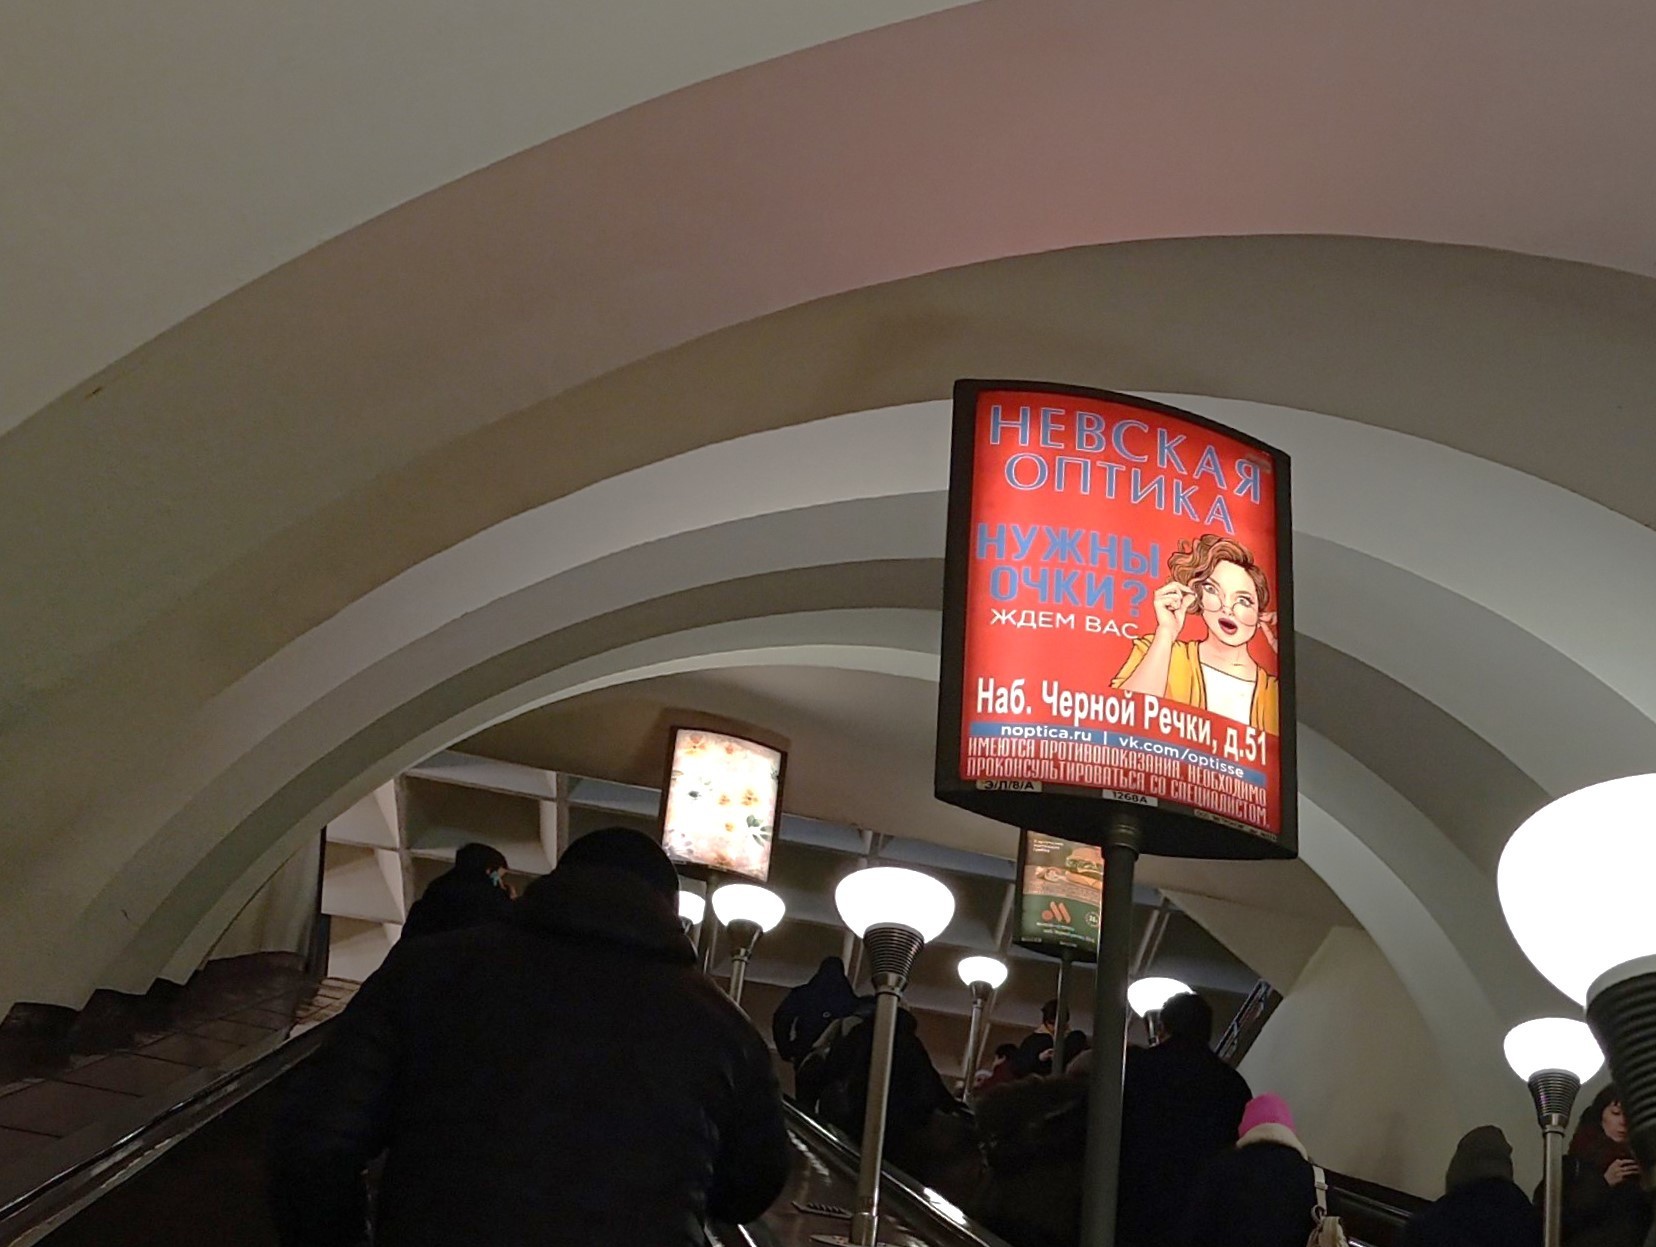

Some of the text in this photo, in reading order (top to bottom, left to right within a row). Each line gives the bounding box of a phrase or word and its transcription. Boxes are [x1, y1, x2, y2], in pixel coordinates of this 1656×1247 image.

[989, 405, 1260, 504] НЕВСКАЯ
[1005, 453, 1235, 534] ОПТИКА
[977, 523, 1159, 578] НУЖНЫ
[989, 564, 1148, 617] ОЧКИ?
[991, 608, 1139, 639] ЖДЕМ ВАС
[976, 677, 1267, 765] Наб. Черной Речки, д.51
[1001, 725, 1092, 742] noptica.ru
[967, 757, 1145, 792] ПРОКОНСУЛЬТИРОВАТЬСЯ
[1151, 777, 1166, 795] СО
[968, 737, 1035, 758] ИМЕЮТСЯ
[1188, 764, 1266, 806] НЕОБХОДИМО
[1119, 736, 1244, 778] vk.com/optisse
